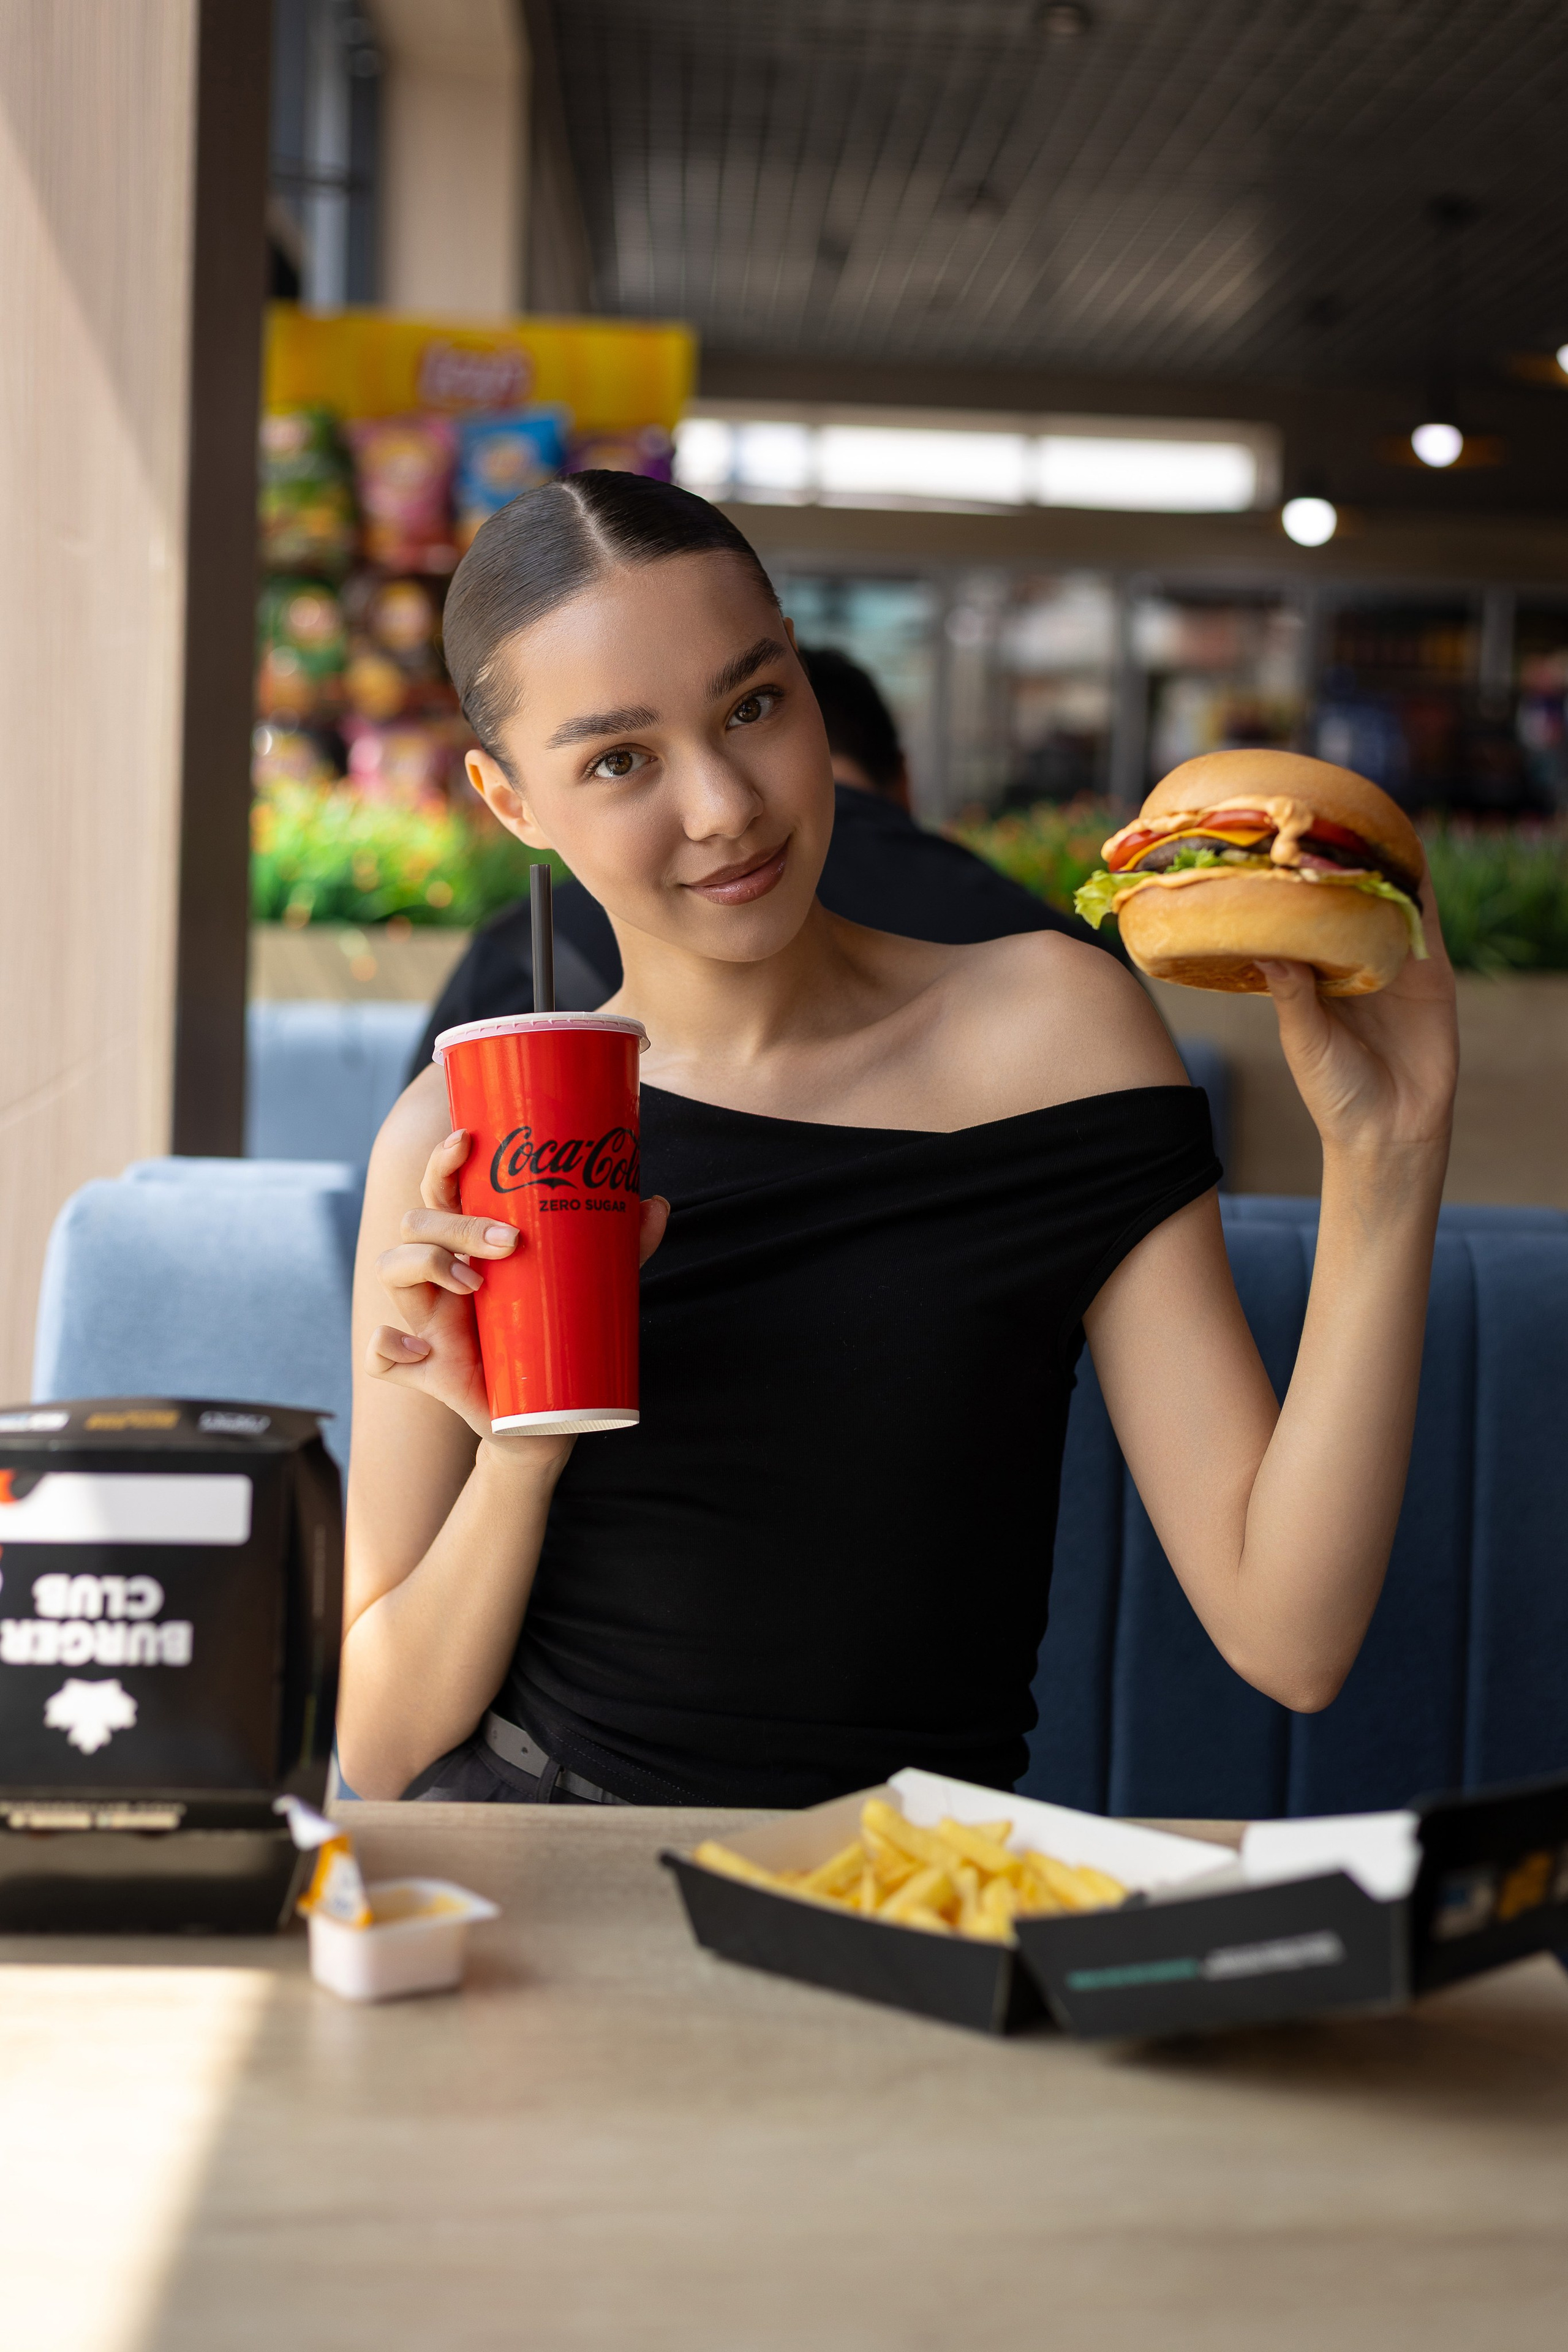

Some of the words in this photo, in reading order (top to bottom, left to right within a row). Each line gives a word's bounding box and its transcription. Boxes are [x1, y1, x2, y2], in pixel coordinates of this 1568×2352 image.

[539, 1199, 581, 1212] ZERO
[585, 1199, 626, 1213] SUGAR
[32, 1574, 164, 1620] CLUB
[0, 1620, 193, 1667] BURGER
